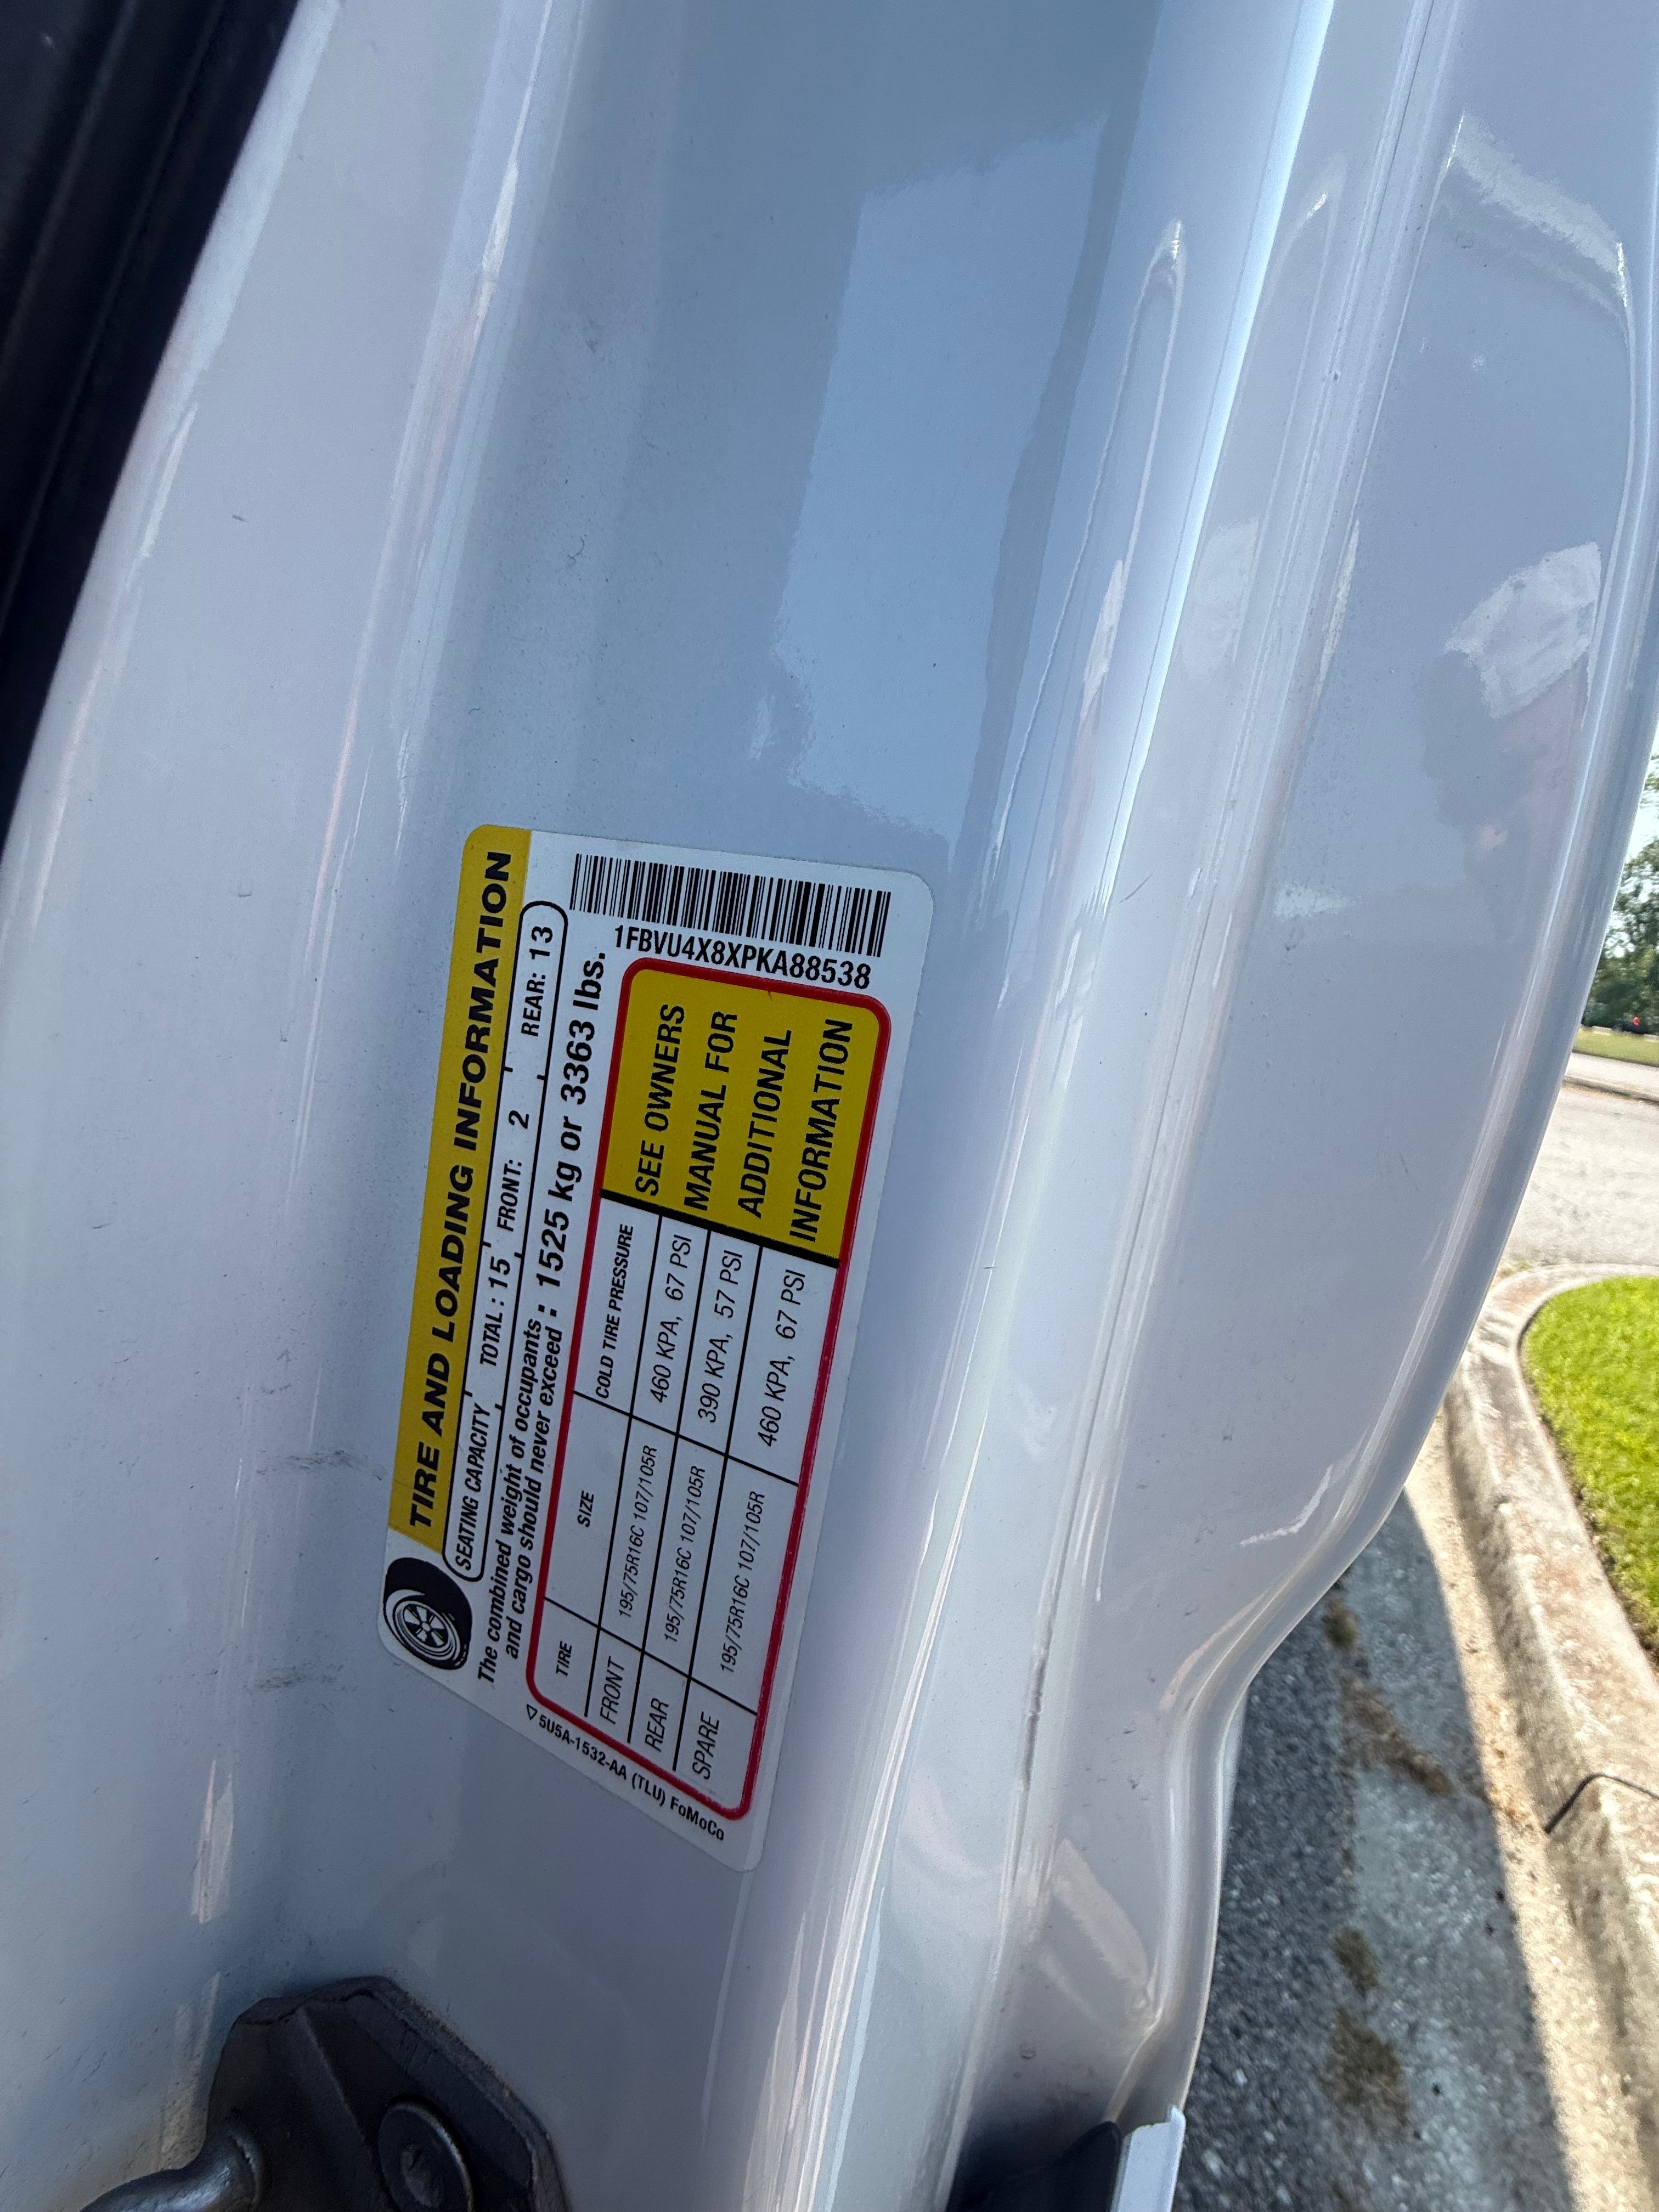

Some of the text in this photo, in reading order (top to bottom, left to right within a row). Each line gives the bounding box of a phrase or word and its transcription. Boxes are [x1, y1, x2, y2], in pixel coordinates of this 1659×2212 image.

[529, 926, 552, 960] 13
[573, 953, 605, 1010] lbs.
[615, 925, 871, 989] 1FBVU4X8XPKA88538
[521, 973, 545, 1036] REAR:
[561, 1020, 595, 1105] 3363
[635, 1005, 684, 1196] SEE OWNERS
[509, 1110, 529, 1129] 2
[561, 1116, 582, 1151] or
[684, 1012, 737, 1211] MANUAL FOR
[738, 1030, 792, 1219] ADDITIONAL
[789, 1019, 853, 1242] INFORMATION
[410, 852, 511, 1527] TIRE AND LOADING INFORMATION
[497, 1160, 522, 1232] FRONT:
[548, 1161, 582, 1201] kg
[488, 1256, 510, 1288] 15
[536, 1209, 569, 1287] 1525
[596, 1224, 633, 1398] COLD TIRE PRESSURE
[650, 1235, 691, 1403] 460 KPA, 67 PSI
[698, 1250, 742, 1423] 390 KPA, 57 PSI
[758, 1269, 805, 1447] 460 KPA, 67 PSI
[465, 1403, 490, 1492] CAPACITY
[455, 1496, 478, 1571] SEATING
[478, 1319, 541, 1683] The combined weight of occupants
[506, 1326, 562, 1660] and cargo should never exceed
[577, 1491, 594, 1527] SIZE
[619, 1446, 657, 1617] 195/75R16C 107/105R
[664, 1466, 705, 1641] 195/75R16C 107/105R
[721, 1492, 765, 1672] 195/75R16C 107/105R
[556, 1641, 572, 1677] TIRE
[600, 1656, 624, 1724] FRONT
[645, 1698, 669, 1752] REAR
[692, 1712, 719, 1780] SPARE
[539, 1714, 724, 1841] 5U5A-1532-AA (TLU) FoMoCo
